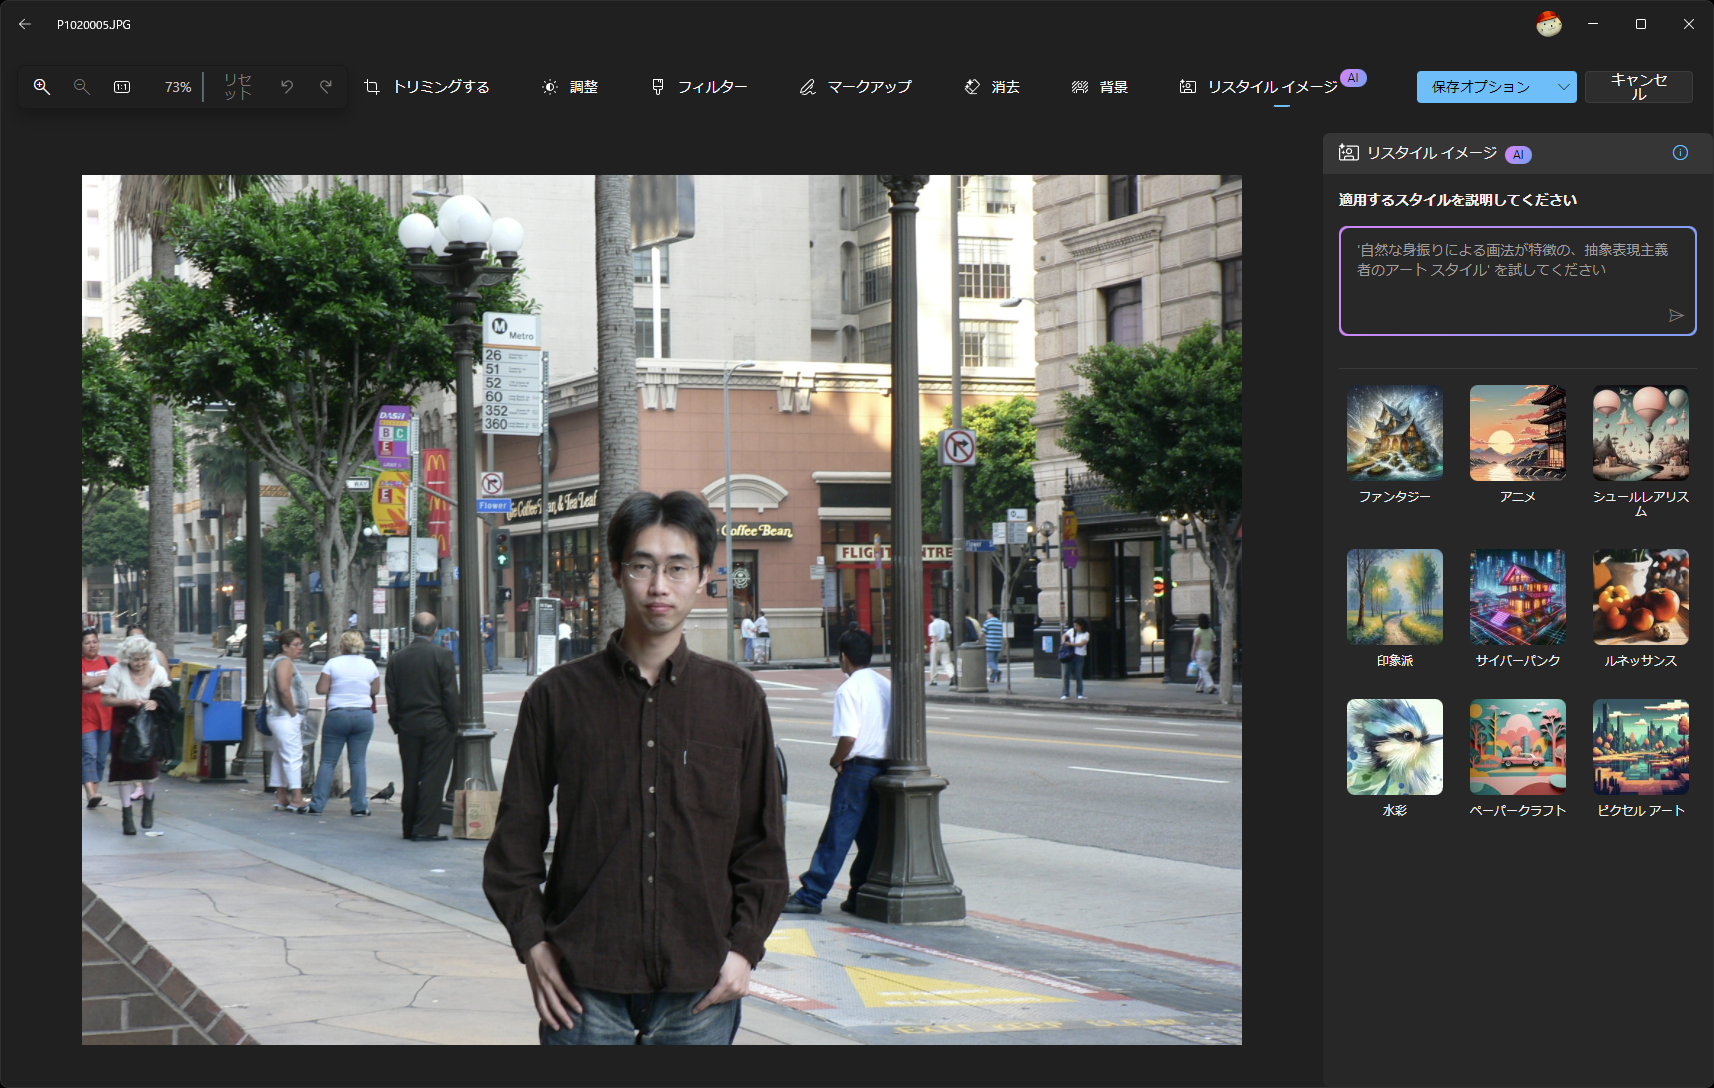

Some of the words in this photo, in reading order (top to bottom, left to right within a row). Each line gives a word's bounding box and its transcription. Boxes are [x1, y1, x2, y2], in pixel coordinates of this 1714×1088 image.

[57, 19, 131, 30] P1020005.JPG
[225, 73, 252, 86] リセ
[1347, 72, 1359, 83] AI
[1610, 72, 1668, 87] キャンセ
[164, 81, 193, 93] 73%
[395, 79, 490, 94] トリミングする
[569, 79, 599, 94] 調整
[678, 79, 748, 94] フィルター
[827, 79, 913, 94] マークアップ
[991, 79, 1021, 94] 消去
[1099, 80, 1129, 94] 背景
[1209, 79, 1279, 94] リスタイル
[1281, 79, 1339, 94] イメージ
[1431, 79, 1530, 94] 保存オプション
[225, 87, 252, 101] ット
[1631, 87, 1648, 101] ル
[1368, 145, 1438, 160] リスタイル
[1440, 146, 1498, 160] イメージ
[1512, 149, 1524, 160] AI
[1338, 192, 1578, 207] 適用するスタイルを説明してください
[1356, 262, 1428, 277] 者のアート
[1494, 262, 1606, 277] を試してください
[509, 331, 534, 341] Metro
[485, 349, 502, 361] 26
[485, 363, 499, 375] 51
[485, 377, 502, 389] 52
[485, 391, 503, 403] 60
[379, 412, 405, 420] DASH
[485, 404, 508, 417] 352
[484, 418, 508, 430] 360
[383, 428, 390, 438] B
[396, 428, 404, 439] C
[382, 441, 390, 451] E
[381, 488, 390, 499] E
[1359, 490, 1432, 503] ファンタジー
[1499, 491, 1536, 503] アニメ
[1592, 491, 1690, 503] シュールレアリス
[479, 501, 507, 510] Flower
[517, 499, 538, 517] Coffee
[564, 492, 578, 511] Tea
[577, 489, 598, 508] Leaf
[1634, 505, 1648, 517] ム
[721, 524, 758, 537] Coffee
[758, 524, 794, 539] Bean
[1376, 653, 1414, 667] 印象派
[1475, 654, 1561, 667] サイバーパンク
[1603, 654, 1678, 667] ルネッサンス
[1381, 803, 1408, 817] 水彩
[1468, 804, 1567, 817] ペーパークラフト
[1598, 804, 1647, 817] ピクセル
[1649, 804, 1686, 817] アート
[894, 1023, 974, 1034] EXIT
